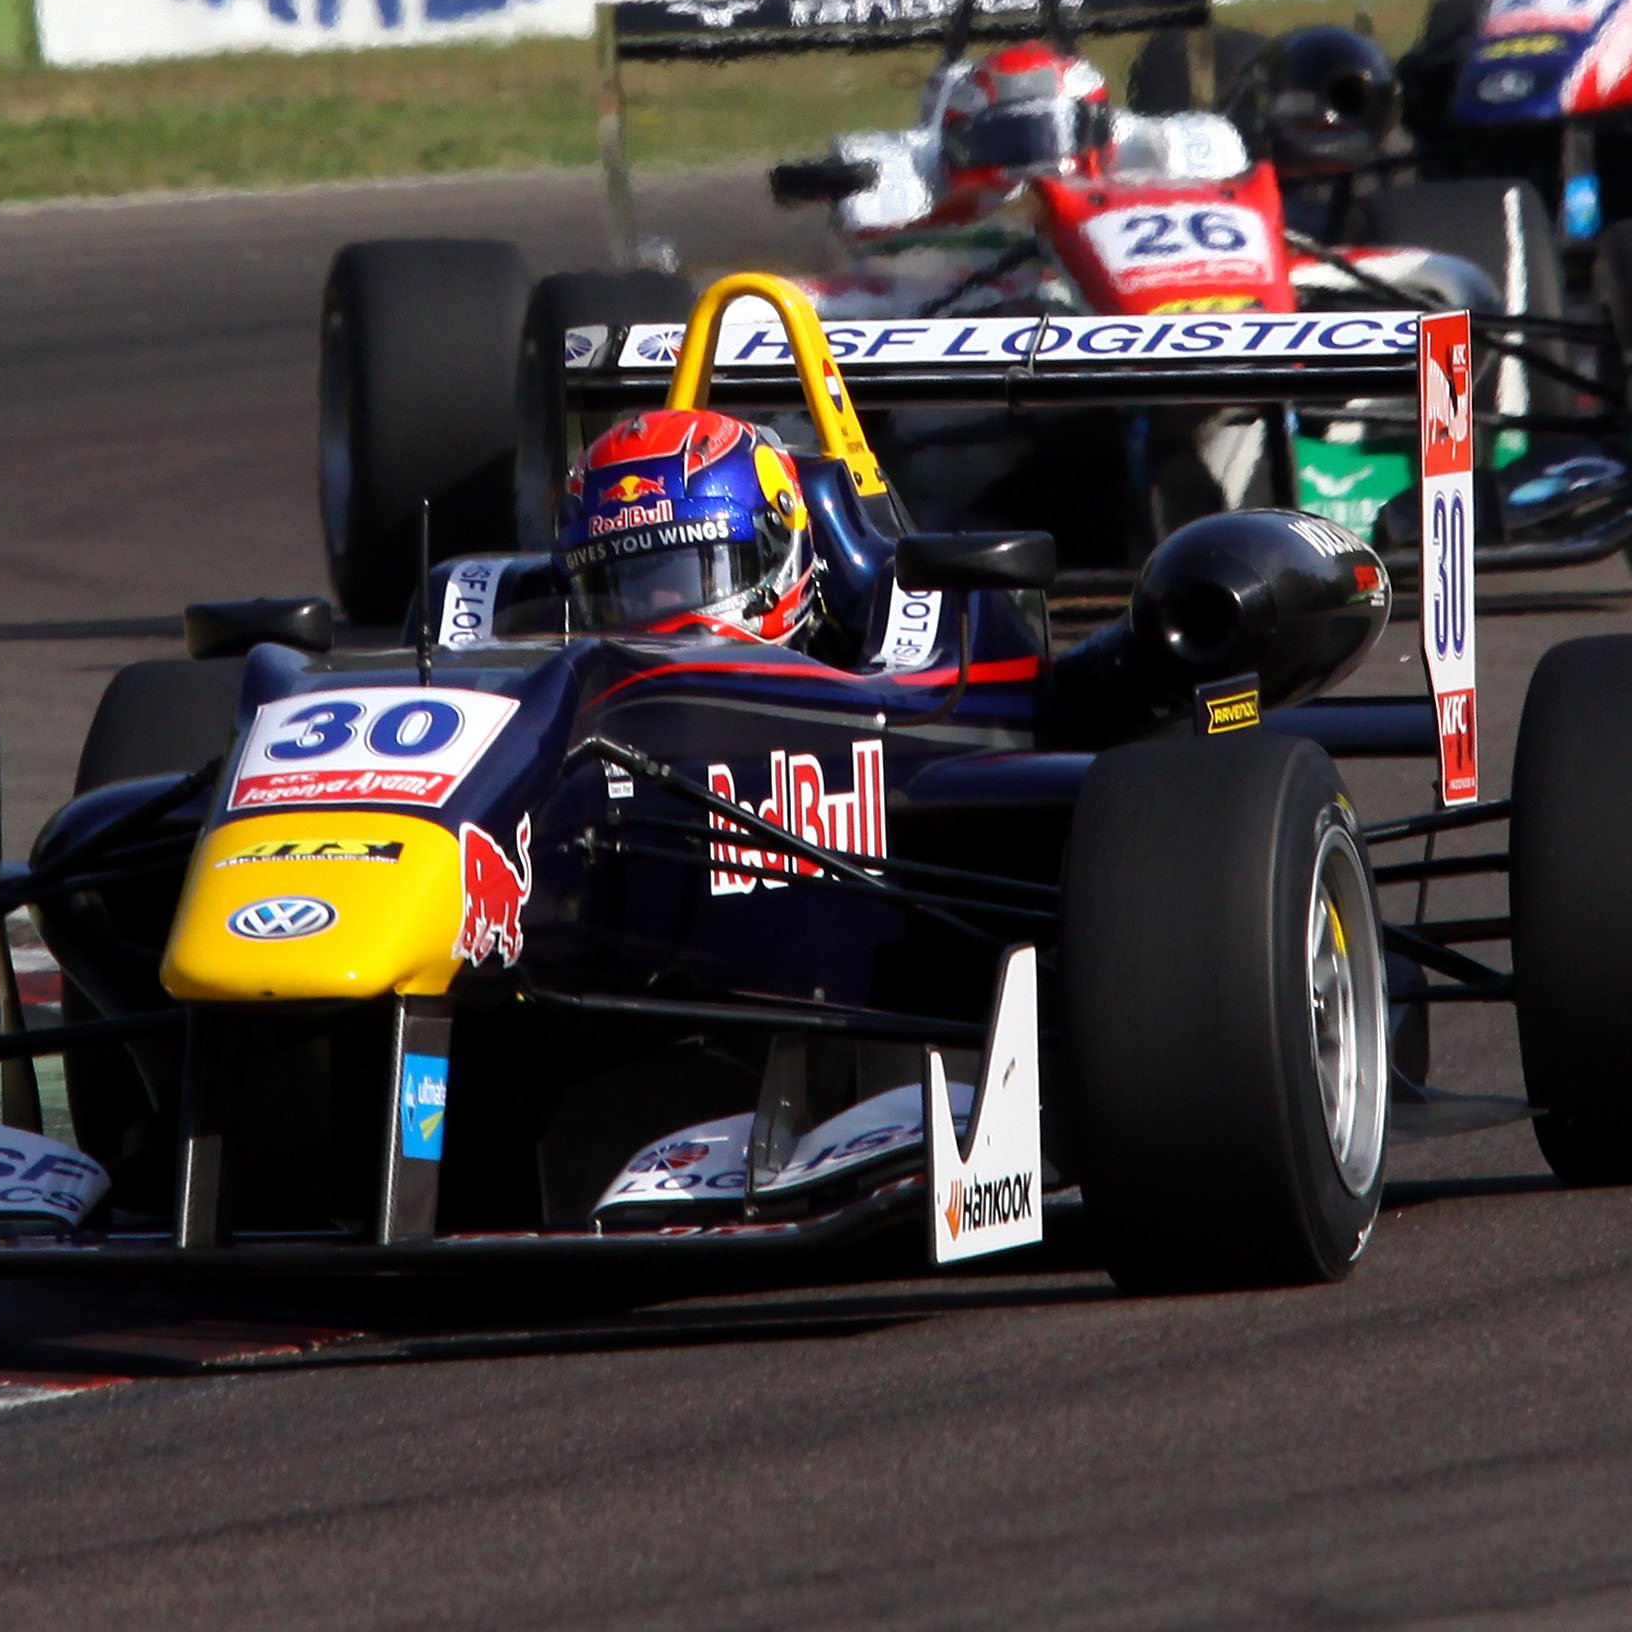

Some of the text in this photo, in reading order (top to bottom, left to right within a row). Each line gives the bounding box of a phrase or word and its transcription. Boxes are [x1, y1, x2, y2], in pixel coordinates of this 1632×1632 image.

[1120, 210, 1247, 259] 26
[735, 319, 1419, 360] HSF LOGISTICS
[566, 519, 730, 571] GIVES YOU WINGS
[1433, 489, 1465, 661] 30
[266, 699, 465, 761] 30
[1442, 694, 1467, 735] KFC
